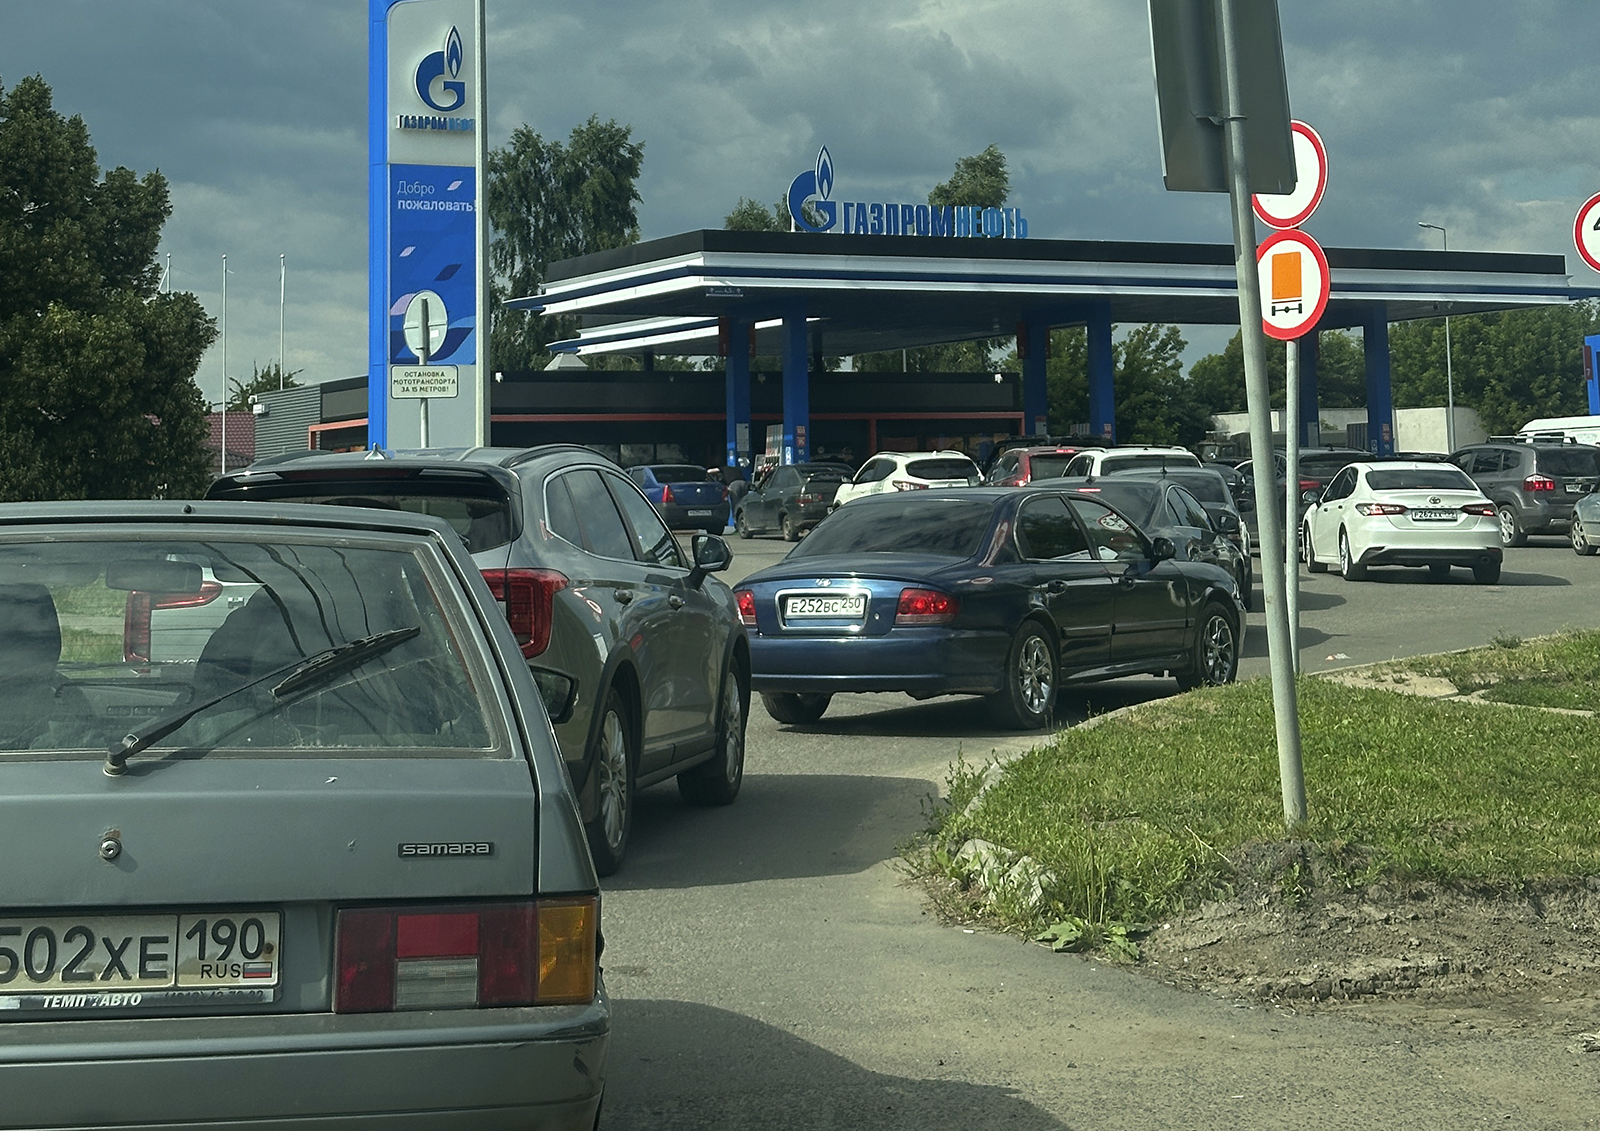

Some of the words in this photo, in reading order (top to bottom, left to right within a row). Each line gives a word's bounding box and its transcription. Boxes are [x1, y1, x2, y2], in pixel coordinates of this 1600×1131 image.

[397, 180, 435, 196] Добро
[841, 597, 861, 609] 250
[185, 918, 265, 961] 190
[200, 964, 241, 979] RUS
